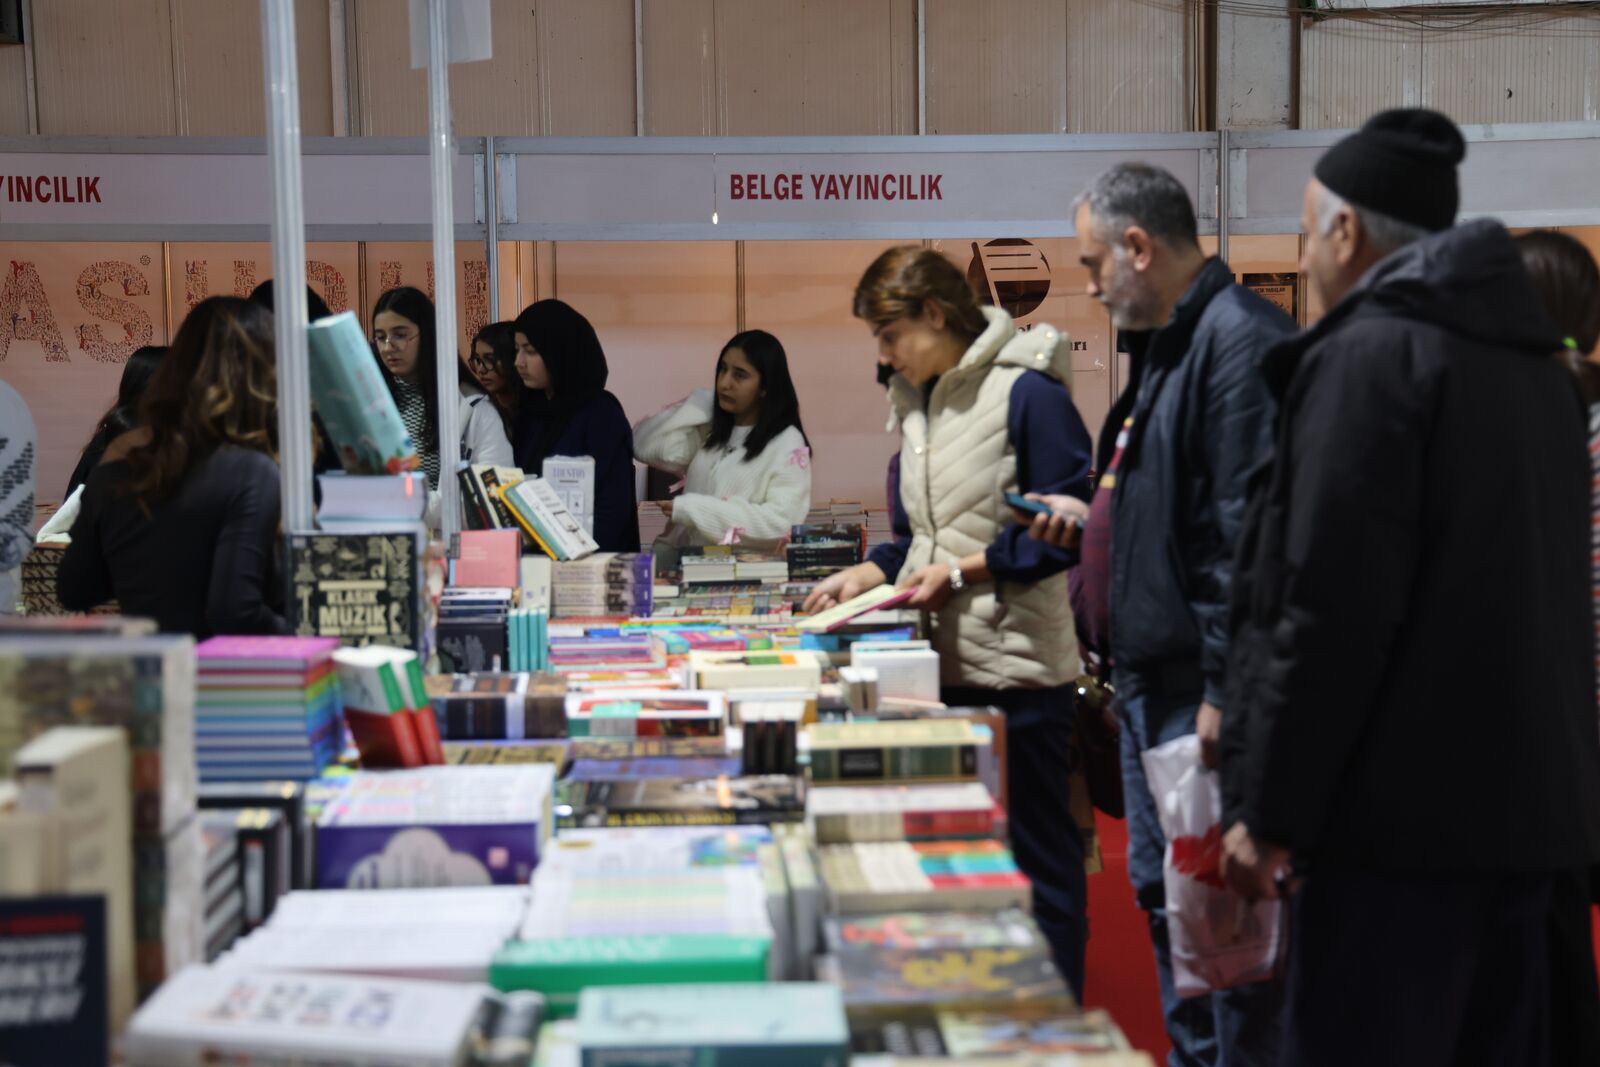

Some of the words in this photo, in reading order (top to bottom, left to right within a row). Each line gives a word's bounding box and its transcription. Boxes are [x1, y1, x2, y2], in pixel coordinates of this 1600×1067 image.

[730, 174, 803, 200] BELGE
[811, 174, 943, 200] YAYINCILIK
[1070, 341, 1087, 351] rı
